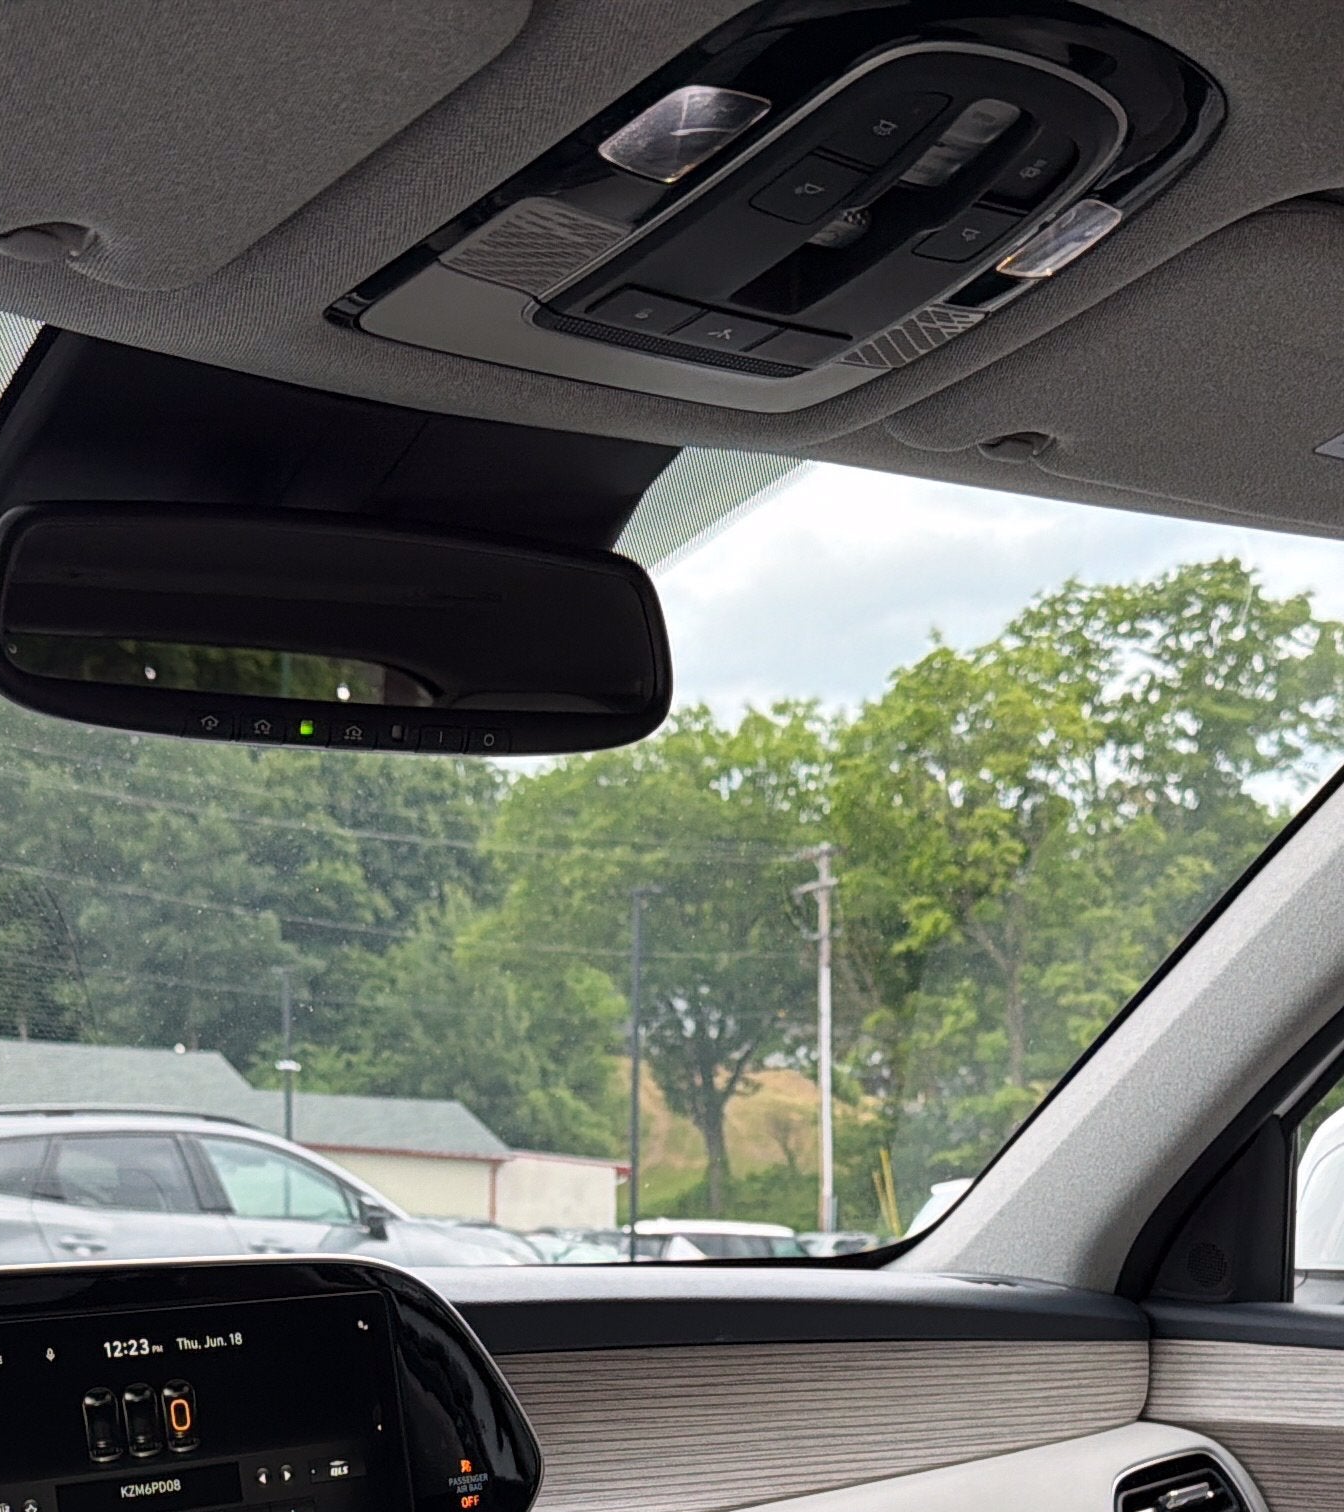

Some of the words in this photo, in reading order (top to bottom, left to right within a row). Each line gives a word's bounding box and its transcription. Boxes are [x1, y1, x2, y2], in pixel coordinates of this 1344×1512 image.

[204, 1335, 227, 1348] Jun.
[229, 1332, 243, 1346] 18
[104, 1338, 150, 1358] 12:23
[449, 1473, 489, 1487] PASSENGER
[461, 1495, 480, 1509] OFF
